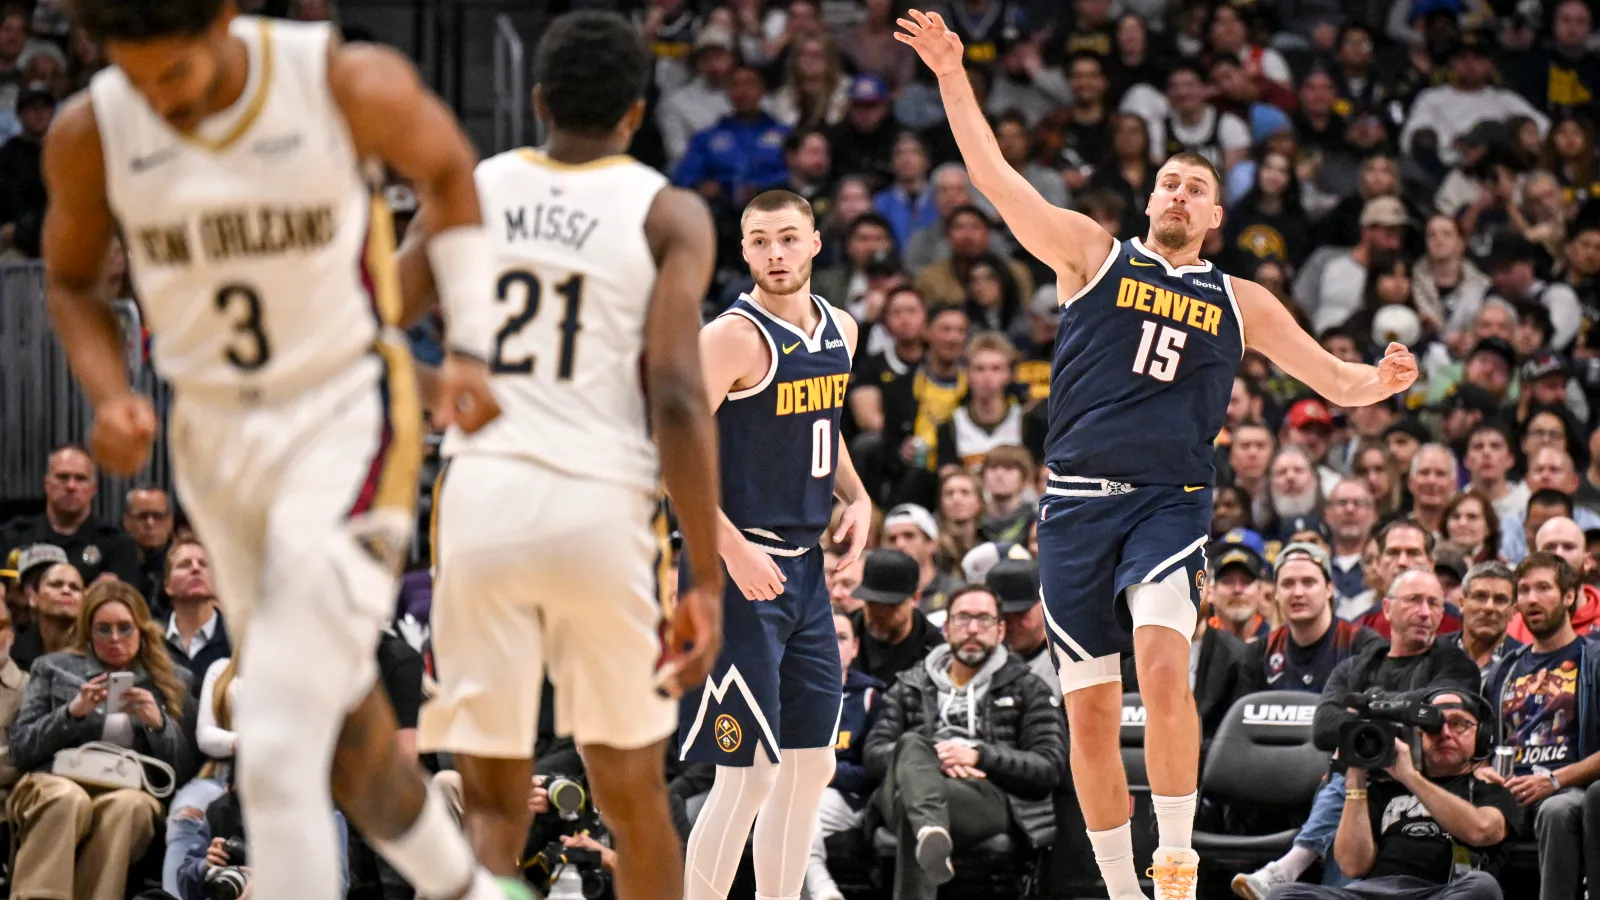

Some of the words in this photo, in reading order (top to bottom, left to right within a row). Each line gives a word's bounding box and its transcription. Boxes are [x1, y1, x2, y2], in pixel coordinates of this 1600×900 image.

[200, 205, 336, 261] ORLEANS
[504, 204, 599, 250] MISSI
[1115, 277, 1222, 336] DENVER
[1192, 278, 1222, 292] ibotta
[213, 281, 270, 371] 3
[490, 268, 585, 381] 21
[824, 339, 844, 349] ibotta
[1131, 319, 1188, 382] 15
[811, 418, 832, 479] 0
[1521, 743, 1568, 765] JOKIĆ
